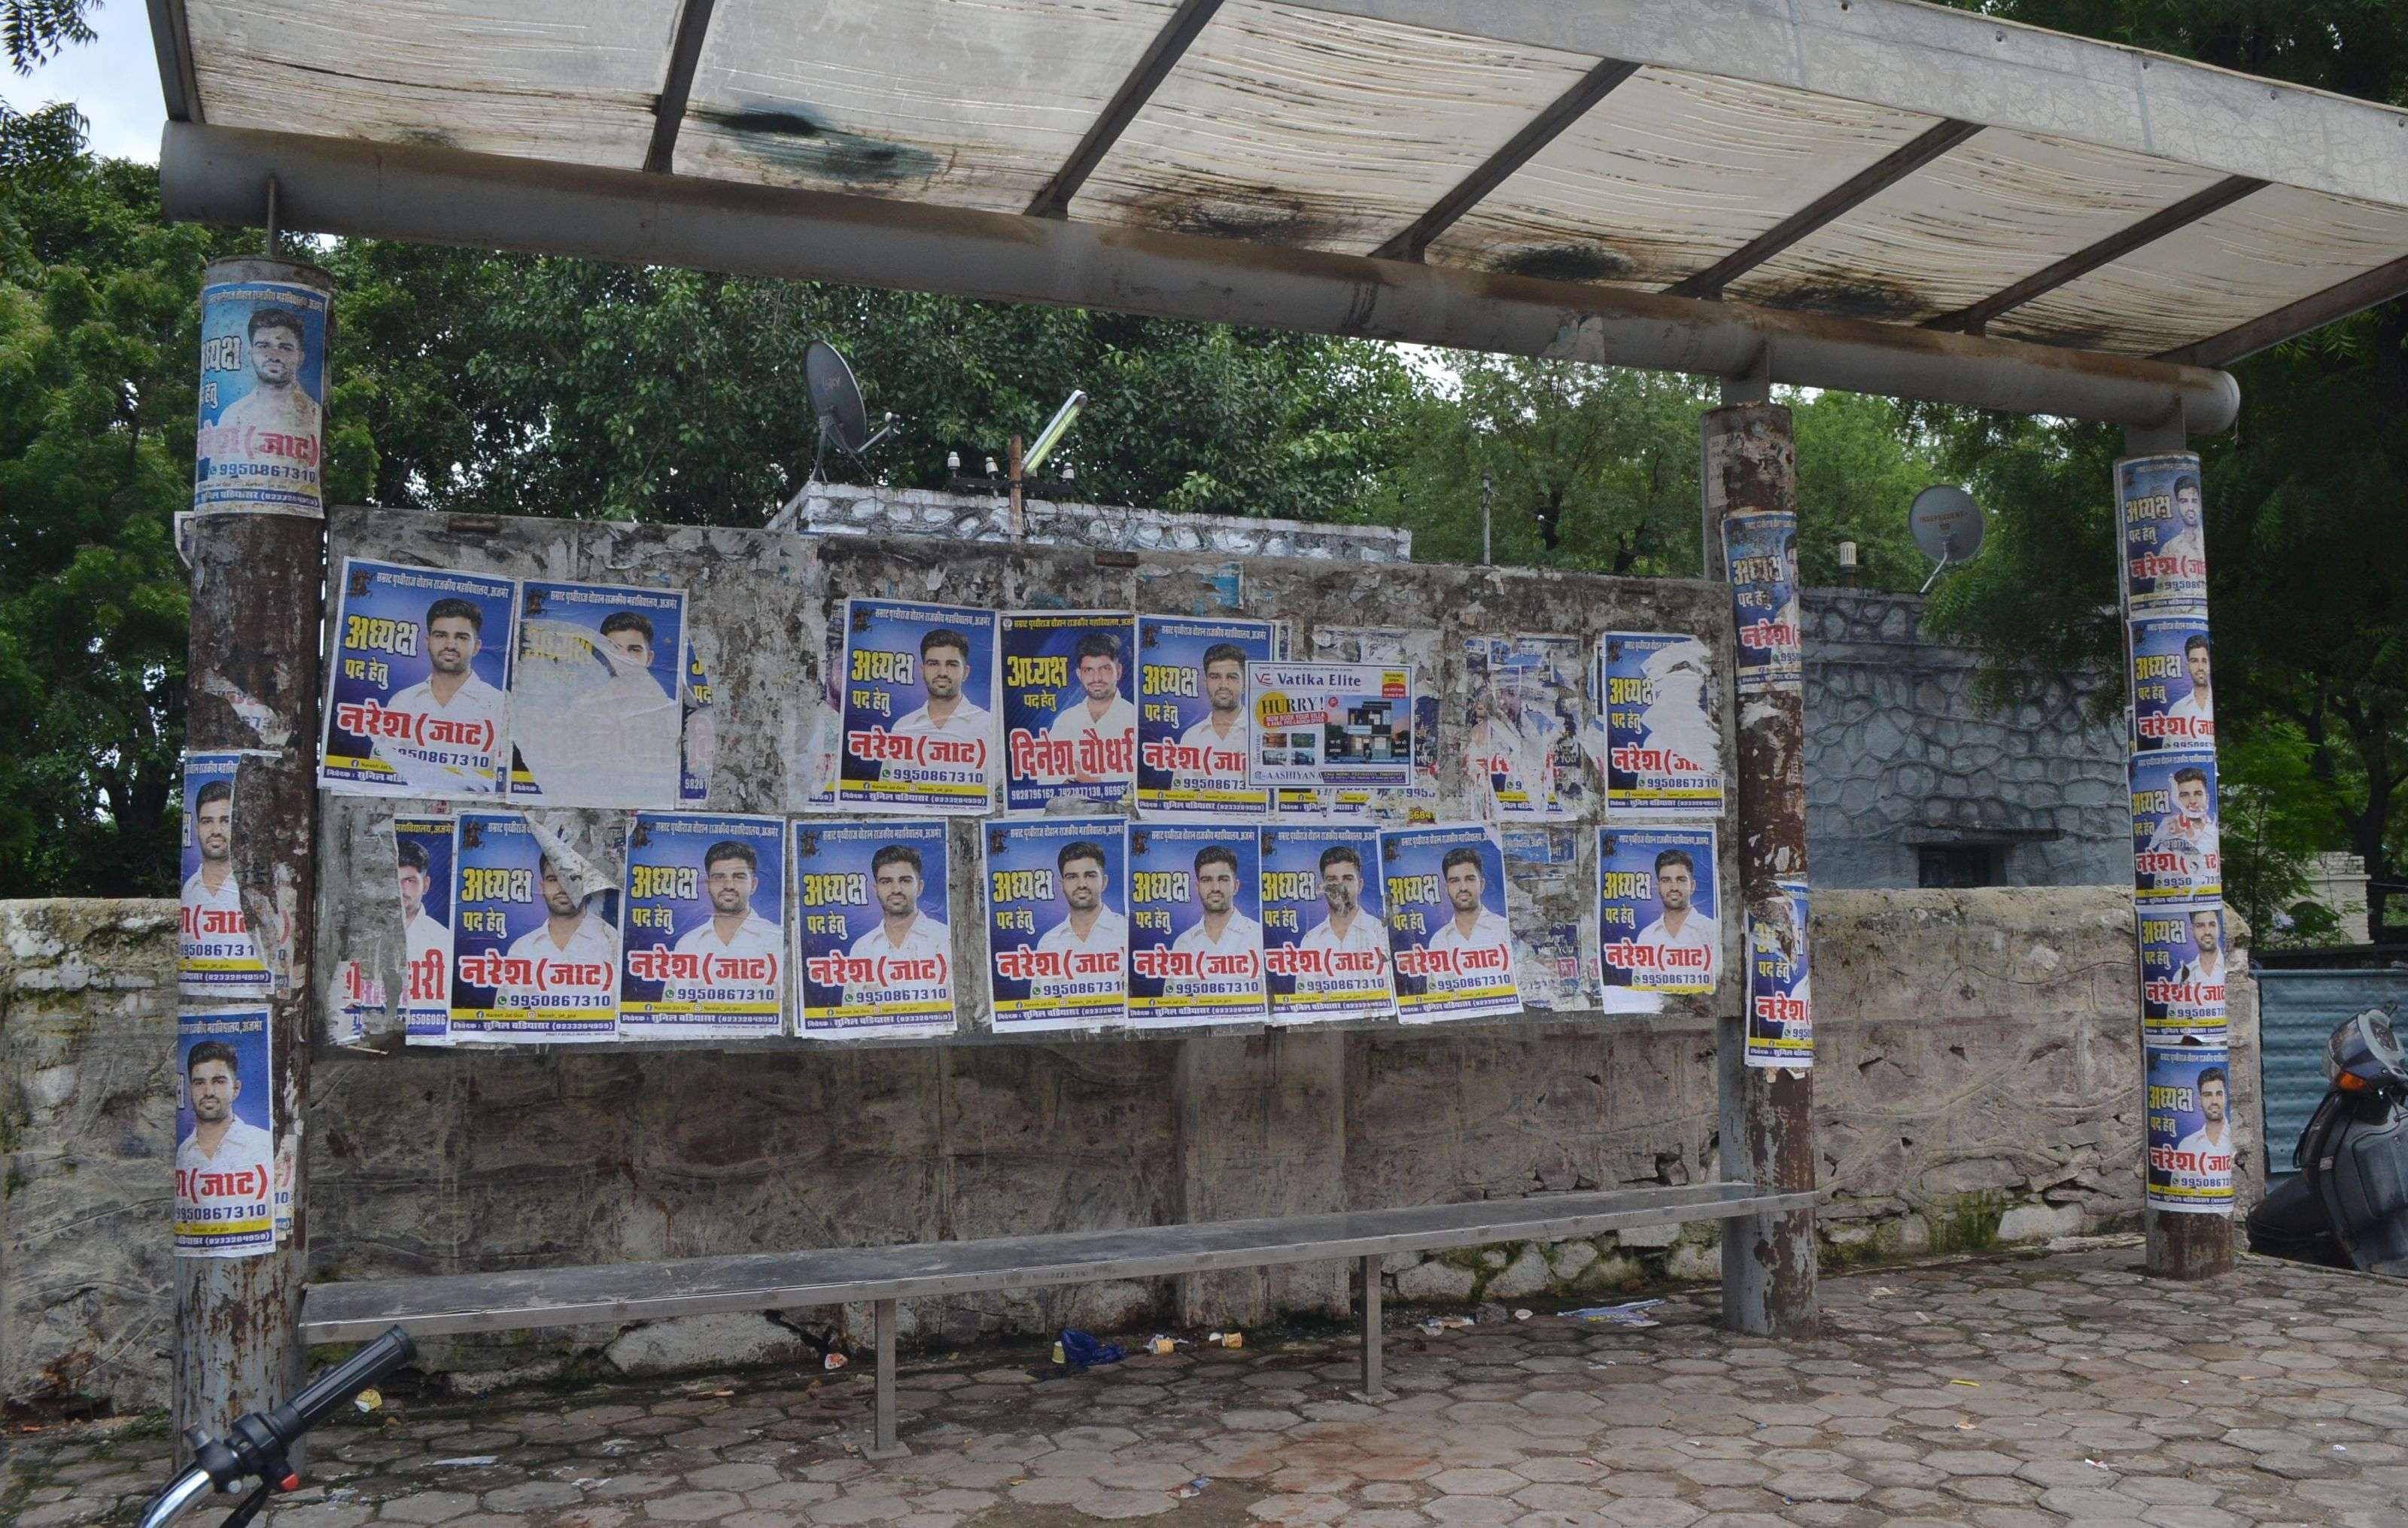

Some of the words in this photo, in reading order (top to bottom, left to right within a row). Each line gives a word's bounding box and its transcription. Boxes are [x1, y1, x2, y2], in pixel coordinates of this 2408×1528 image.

[219, 464, 315, 482] 9950867310
[2126, 495, 2173, 523] अध्यक्ष
[2129, 529, 2139, 542] पद
[2143, 525, 2157, 545] हेतु
[2131, 552, 2178, 578] नरेश
[1738, 593, 1753, 607] पद
[344, 614, 418, 657] अध्यक्ष
[1742, 620, 1790, 649] नरेश
[345, 659, 367, 679] पद
[369, 656, 389, 690] हेतु
[851, 651, 914, 685] अध्यक्ष
[1008, 656, 1067, 688] अध्यक्ष
[1277, 673, 1324, 686] Vatika
[1330, 674, 1361, 686] Elite
[2136, 654, 2182, 680] अध्यक्ष
[1142, 665, 1198, 699] अध्यक्ष
[2139, 687, 2149, 699] पद
[2151, 683, 2166, 703] हेतु
[853, 690, 870, 708] पद
[872, 689, 891, 717] हेतु
[1023, 694, 1038, 708] पद
[1040, 691, 1057, 711] हेतु
[1262, 697, 1318, 714] HURRY
[338, 702, 412, 738] नरेश
[1145, 703, 1160, 722] पद
[1163, 702, 1179, 729] हेतु
[1612, 714, 1625, 728] पद
[1628, 714, 1641, 734] हेतु
[2140, 714, 2186, 735] नरेश
[394, 747, 489, 767] 950867310
[850, 730, 913, 762] नरेश
[1011, 731, 1075, 778] दिनेश
[1145, 740, 1200, 772] नरेश
[1204, 747, 1246, 774] (जा
[1613, 747, 1661, 772] नरेश
[893, 769, 984, 784] 9950867310
[1647, 779, 1718, 788] 9950867310
[2136, 849, 2177, 873] नरेश
[461, 868, 534, 904] अध्यक्ष
[631, 867, 698, 900] अध्यक्ष
[804, 873, 868, 906] अध्यक्ष
[993, 870, 1054, 903] अध्यक्ष
[1133, 872, 1190, 903] अध्यक्ष
[1261, 872, 1316, 902] अध्यक्ष
[1387, 875, 1440, 906] अध्यक्ष
[1603, 872, 1651, 899] अध्यक्ष
[464, 911, 483, 932] पद
[487, 907, 507, 938] हेतु
[632, 907, 652, 927] पद
[655, 904, 674, 935] हेतु
[807, 915, 825, 934] पद
[829, 910, 848, 940] हेतु
[996, 911, 1014, 929] पद
[1017, 907, 1035, 934] हेतु
[1136, 911, 1152, 929] पद
[1154, 907, 1171, 934] हेतु
[1264, 909, 1280, 927] पद
[1282, 909, 1298, 933] हेतु
[1394, 913, 1407, 931] पद
[1410, 910, 1426, 934] हेतु
[1606, 907, 1619, 923] पद
[1621, 906, 1635, 930] हेतु
[2142, 920, 2186, 944] अध्यक्ष
[460, 951, 532, 985] नरेश
[631, 946, 698, 980] नरेश
[999, 948, 1059, 979] नरेश
[1136, 946, 1193, 977] नरेश
[1266, 943, 1320, 975] नरेश
[1397, 944, 1451, 976] नरेश
[1607, 940, 1654, 969] नरेश
[2145, 951, 2155, 964] पद
[2157, 948, 2170, 969] हेतु
[809, 953, 874, 985] नरेश
[1642, 975, 1710, 984] 9950867310
[1759, 960, 1774, 977] पद
[678, 988, 774, 1000] 9950867310
[856, 988, 947, 1003] 9950867310
[1176, 982, 1259, 994] 9950867310
[1307, 979, 1384, 991] 9950867310
[1437, 975, 1510, 990] 9950867310
[510, 995, 610, 1007] 9950867310
[1758, 994, 1804, 1021] नरेश
[2149, 1086, 2194, 1112] अध्यक्ष
[2163, 1115, 2176, 1137] हेतु
[2151, 1145, 2195, 1171] नरेश
[190, 1165, 268, 1202] (जाट)
